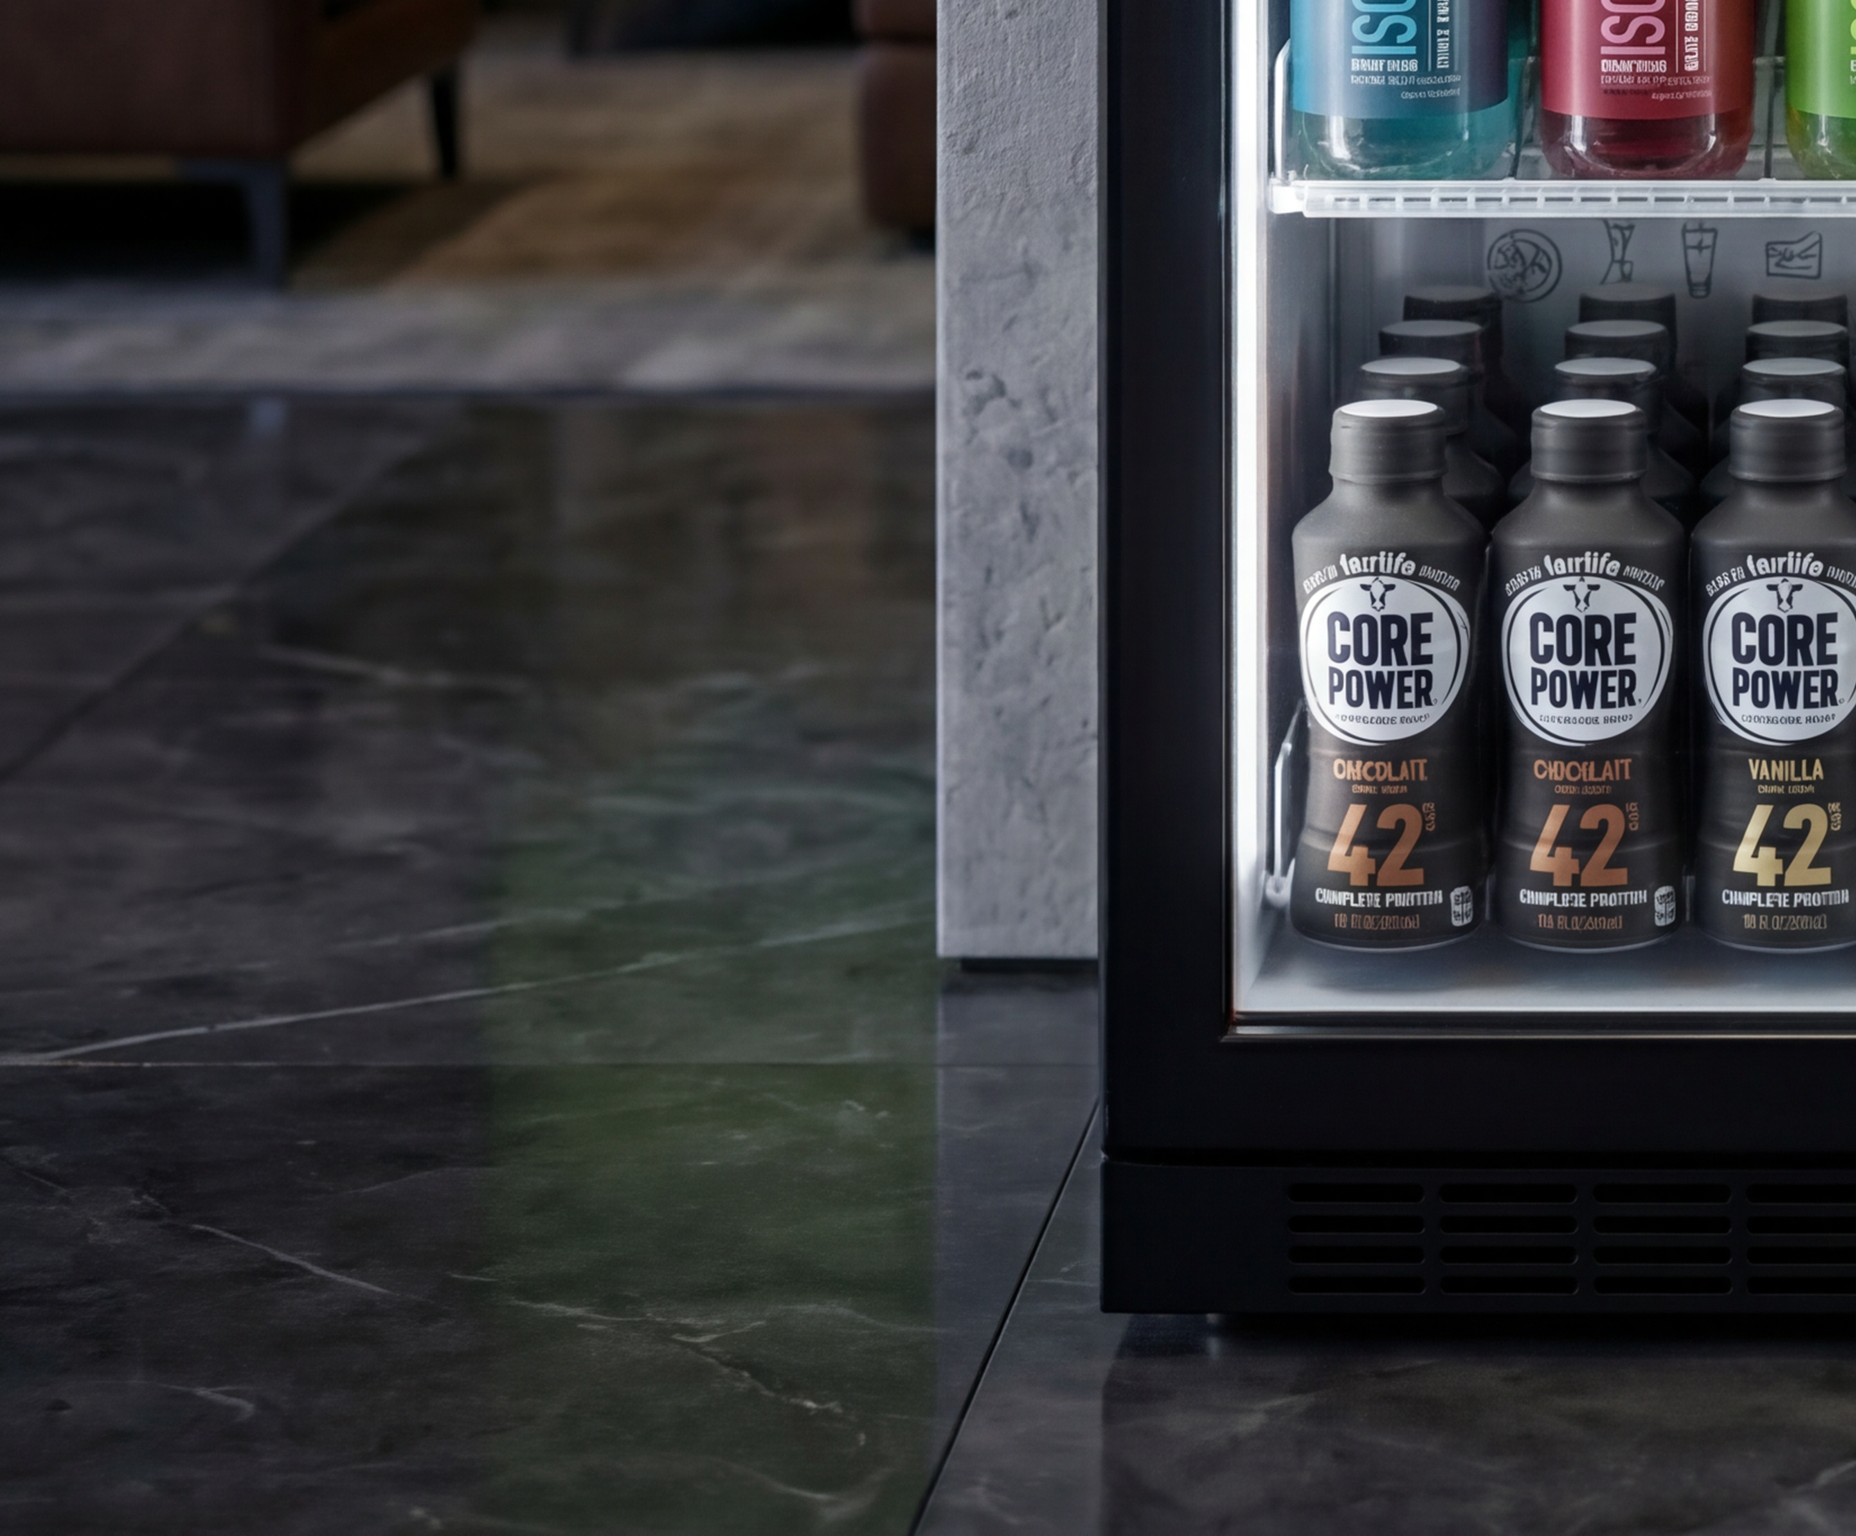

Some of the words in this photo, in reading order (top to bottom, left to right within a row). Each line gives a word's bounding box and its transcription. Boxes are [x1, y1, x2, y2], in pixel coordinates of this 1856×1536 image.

[1327, 611, 1434, 667] CORE
[1529, 611, 1637, 667] CORE
[1731, 611, 1839, 667] CORE
[1328, 666, 1434, 710] POWER
[1530, 666, 1638, 710] POWER
[1732, 666, 1839, 710] POWER
[1748, 757, 1825, 782] VANILLA
[1327, 803, 1425, 887] 42
[1529, 803, 1629, 887] 42
[1732, 803, 1832, 887] 42
